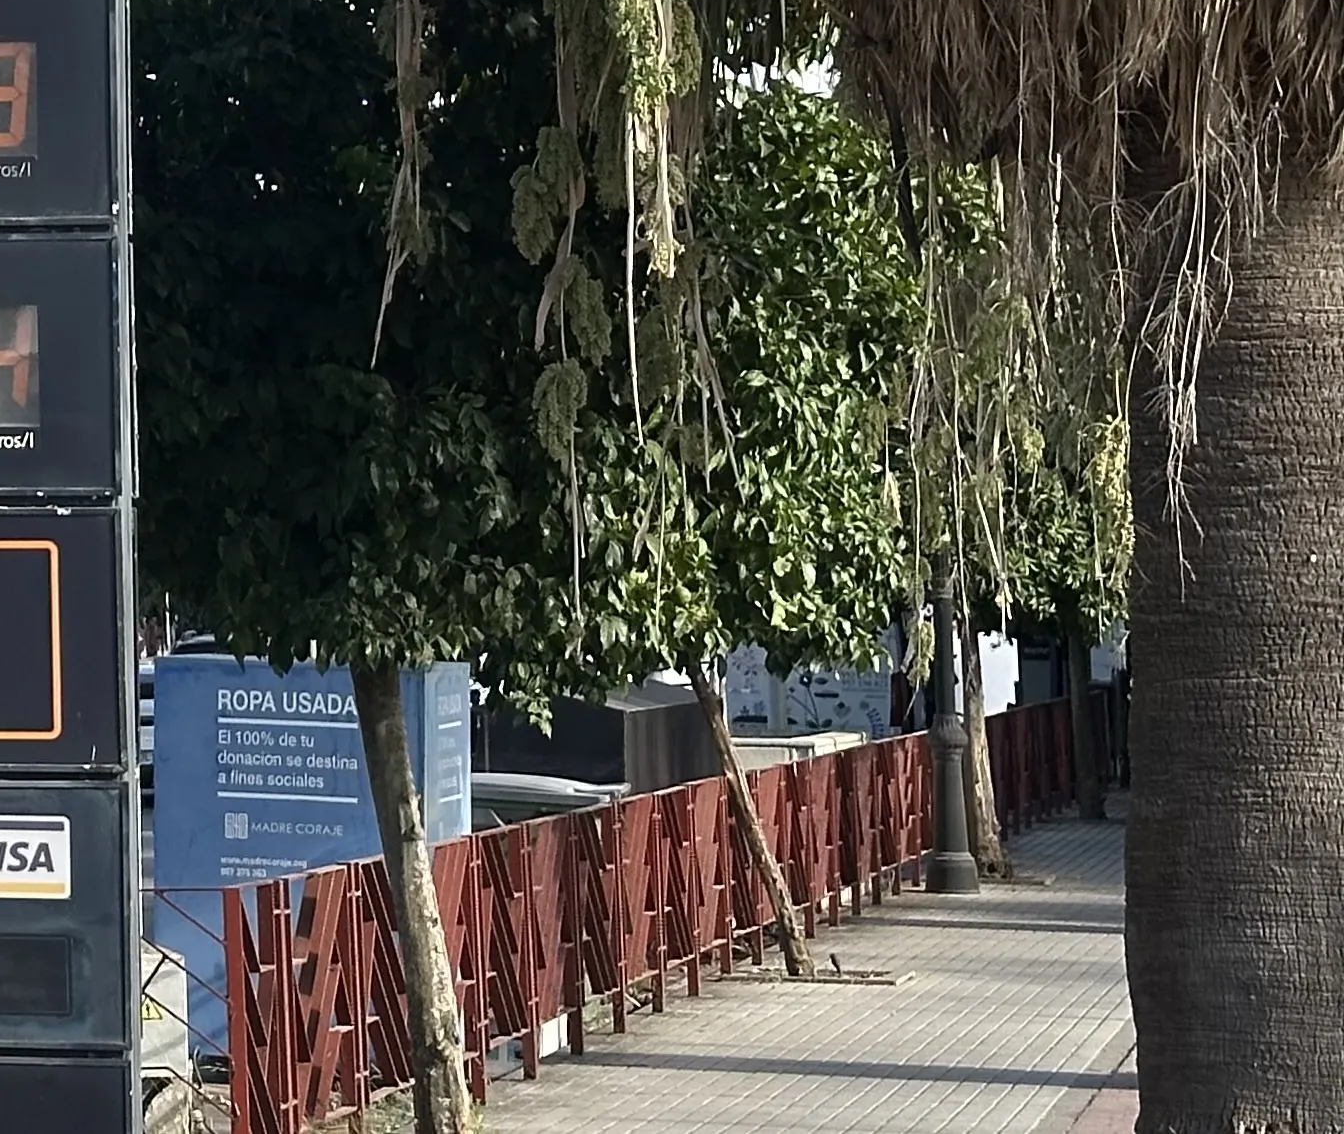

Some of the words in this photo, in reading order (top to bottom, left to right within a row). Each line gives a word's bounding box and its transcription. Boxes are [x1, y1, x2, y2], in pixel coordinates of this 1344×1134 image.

[217, 689, 276, 712] ROPA
[282, 691, 357, 716] USADA
[218, 729, 231, 744] El
[235, 731, 275, 746] 100%
[278, 732, 298, 746] de
[301, 734, 314, 747] tu
[285, 754, 302, 767] se
[306, 753, 358, 771] destina
[217, 773, 226, 785] a
[230, 769, 263, 786] fines
[266, 771, 324, 789] sociales
[250, 822, 292, 834] MADRE
[295, 823, 344, 837] CORAJE
